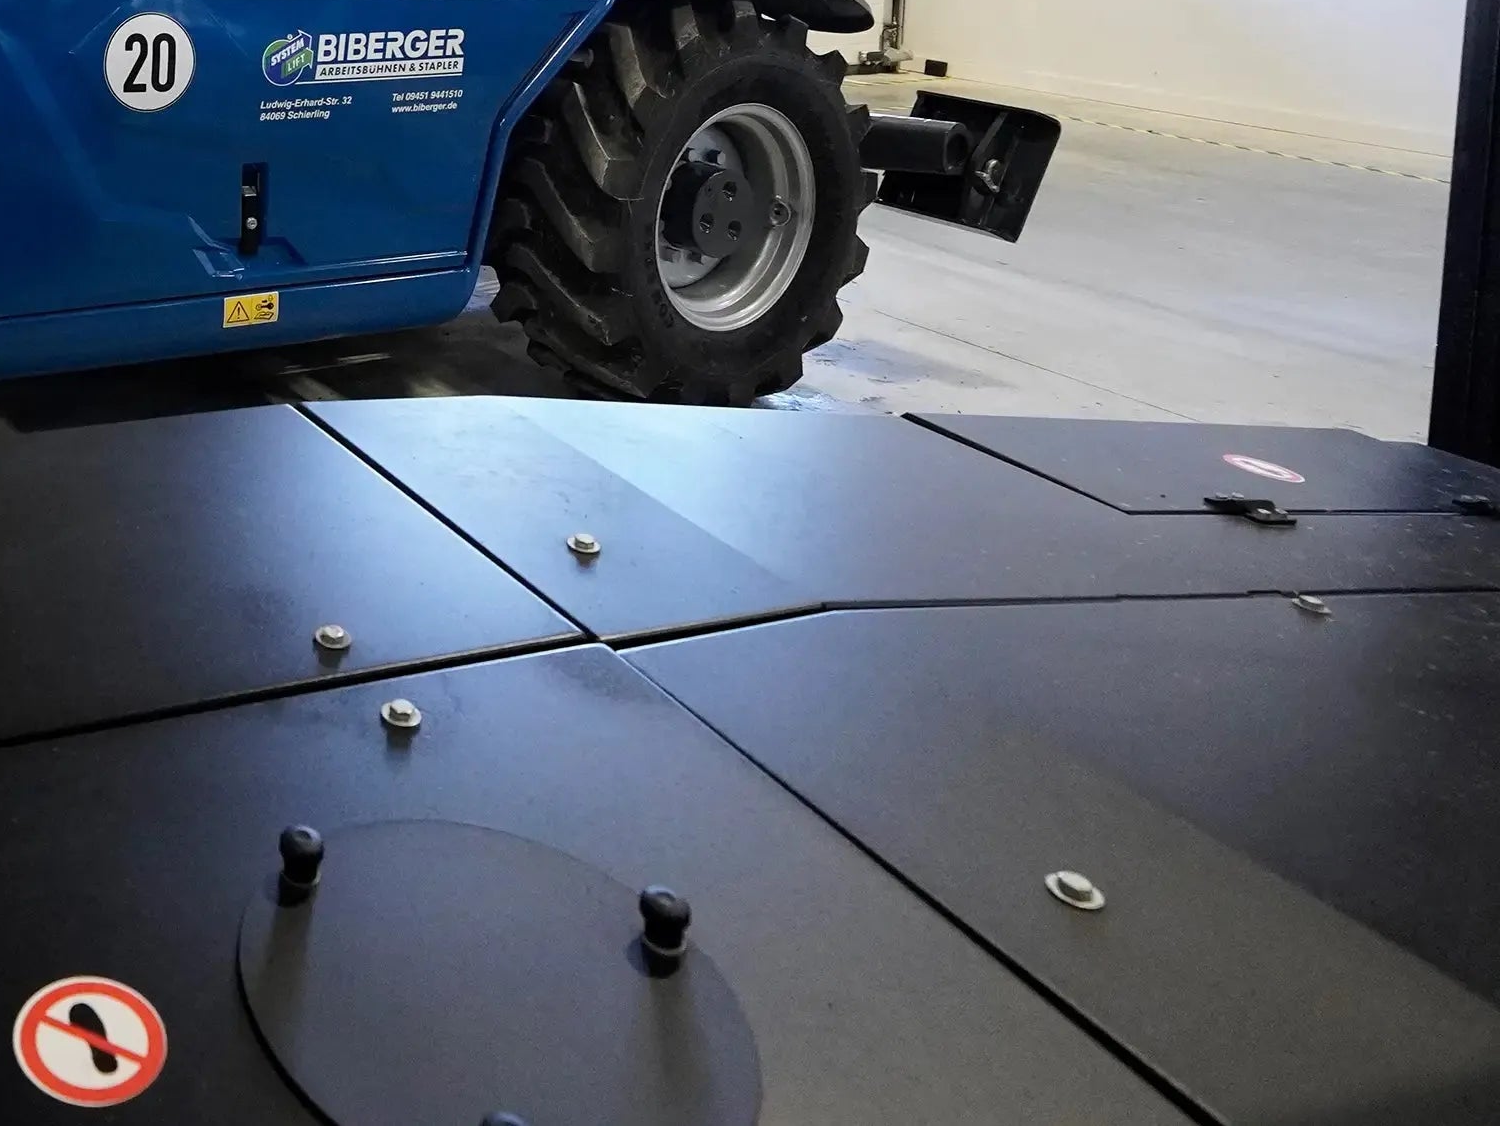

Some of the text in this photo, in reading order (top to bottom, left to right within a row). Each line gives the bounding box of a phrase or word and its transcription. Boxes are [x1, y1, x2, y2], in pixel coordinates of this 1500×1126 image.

[270, 37, 305, 66] SYSTEM
[316, 28, 465, 63] BIBERGER
[123, 32, 177, 93] 20
[287, 53, 306, 72] LIFT
[319, 60, 460, 77] ARBEITSBÜHNEN & STAPLER
[260, 95, 353, 110] Ludwig-Erhard-Str. 32
[391, 89, 464, 102] Tel 09451 9441510
[259, 109, 330, 121] 84069 Schierling
[391, 102, 458, 113] www.biberger.de
